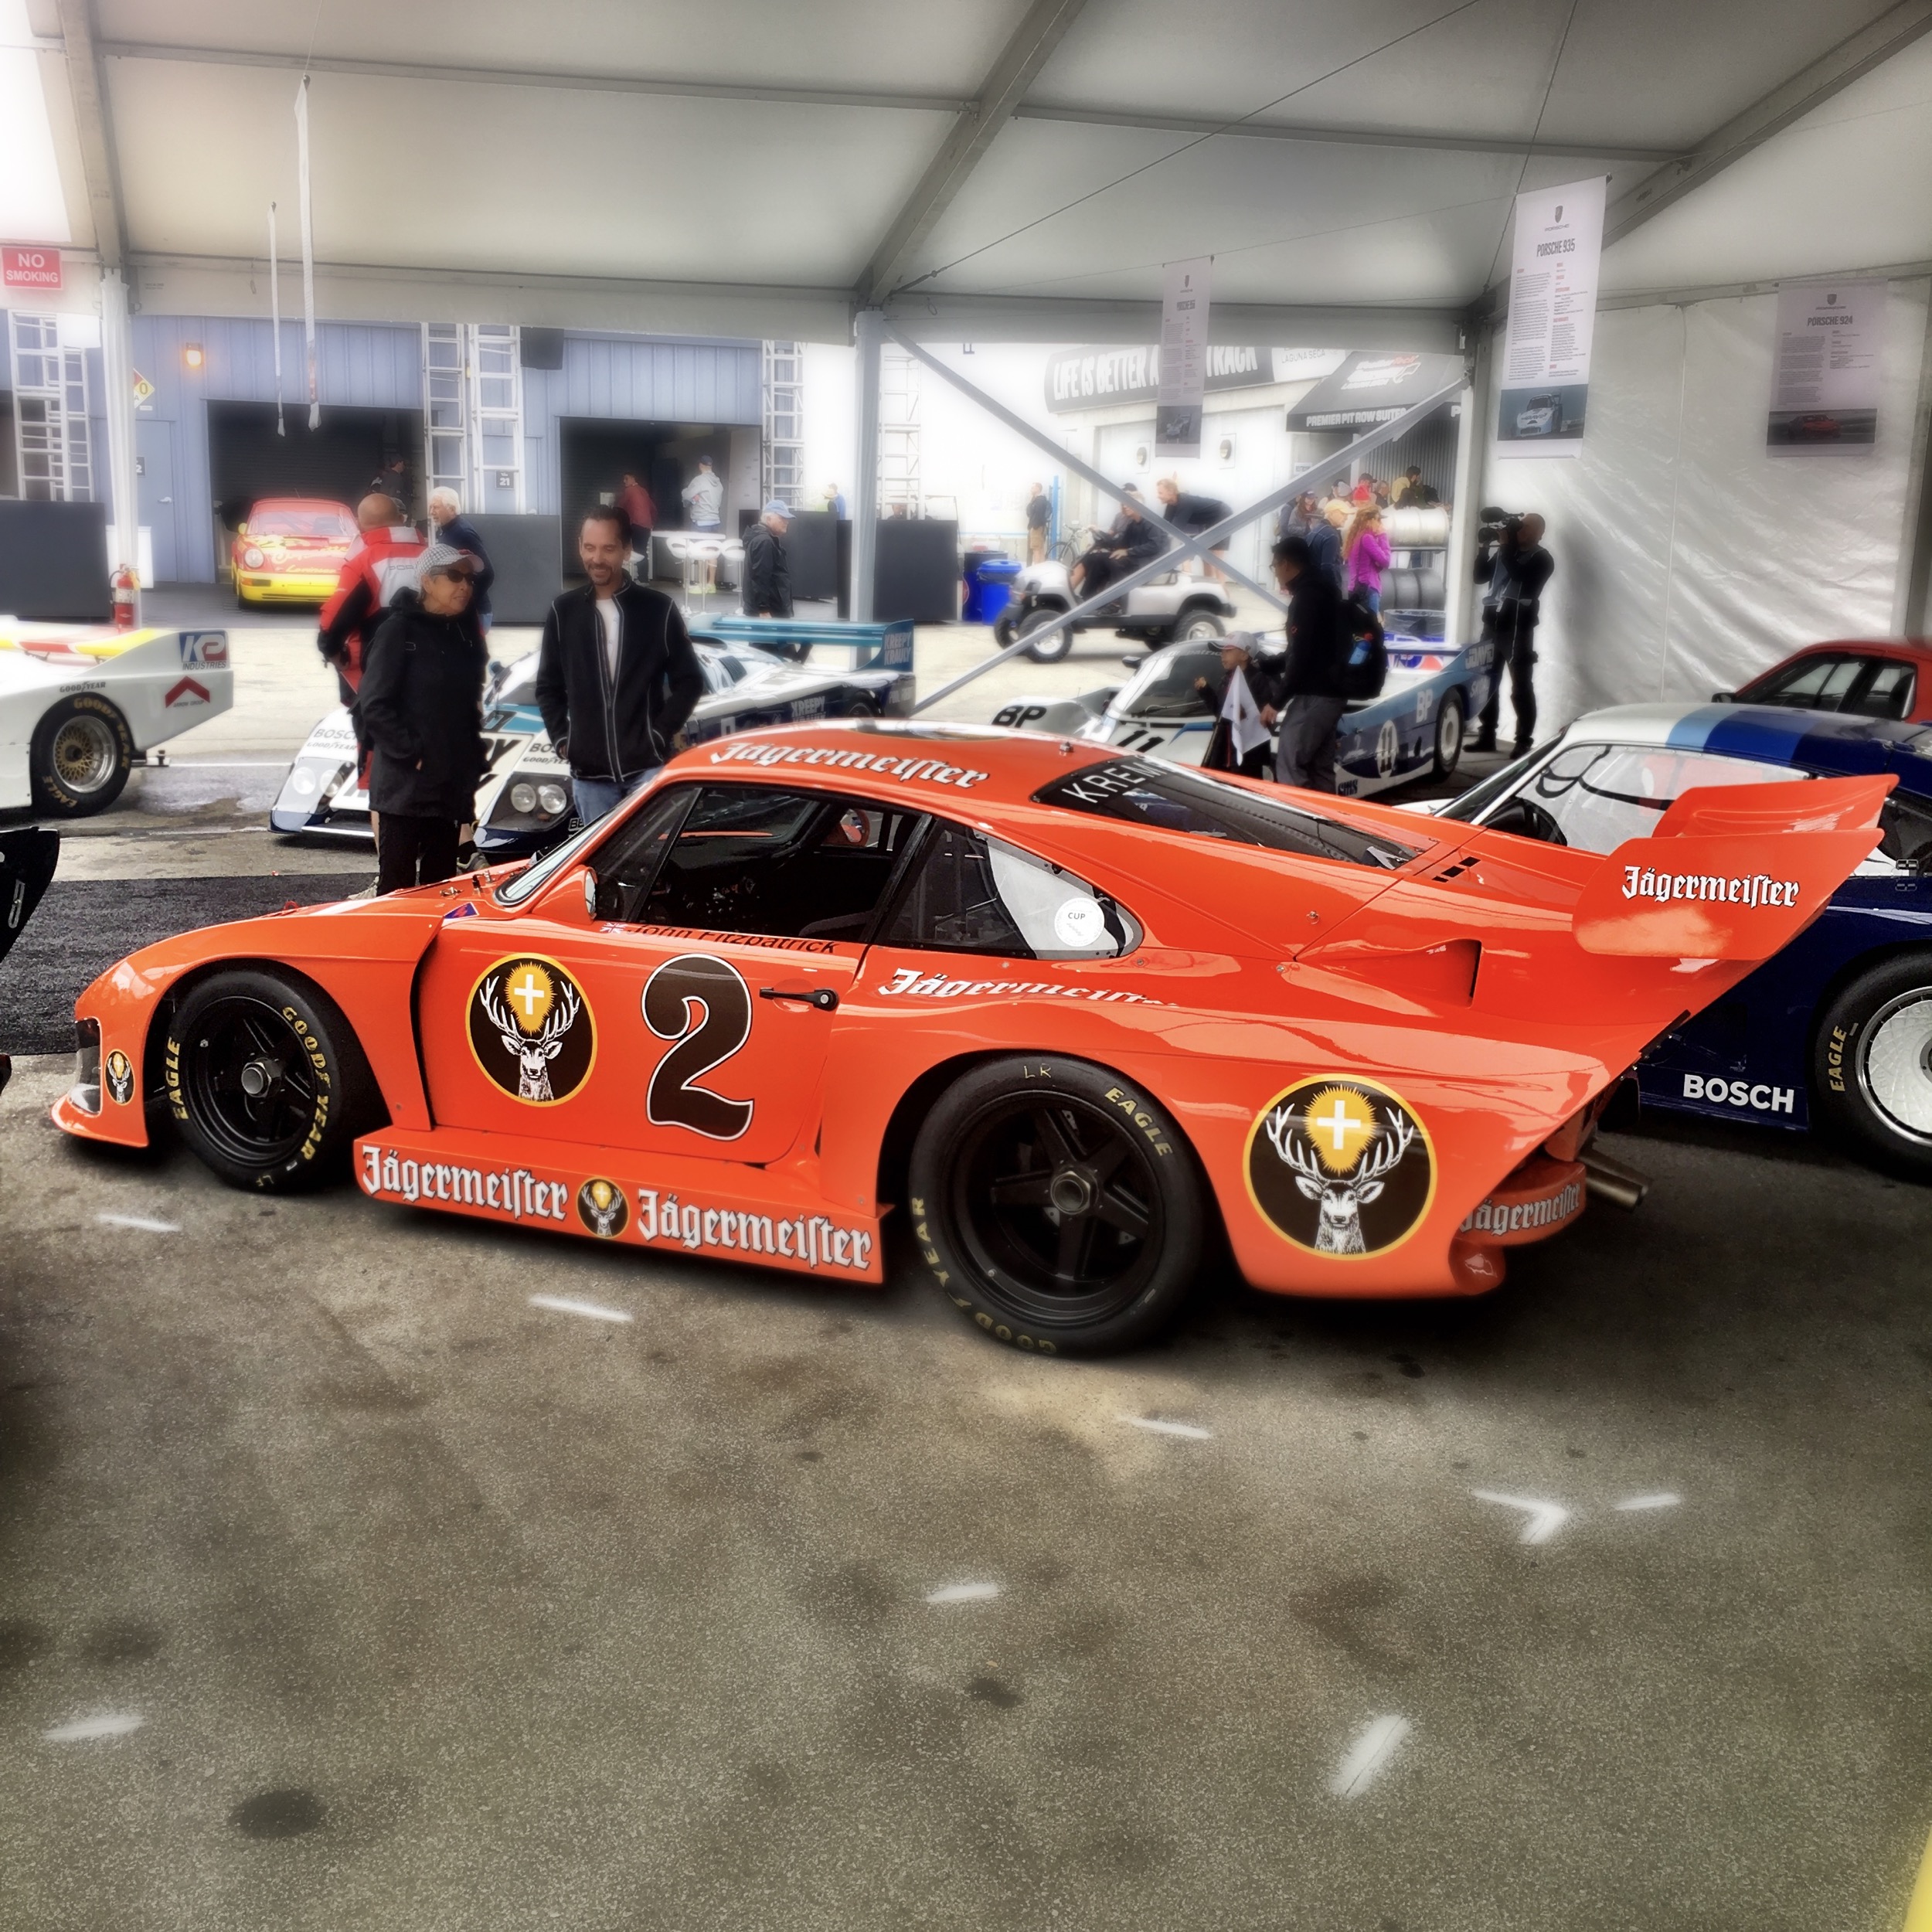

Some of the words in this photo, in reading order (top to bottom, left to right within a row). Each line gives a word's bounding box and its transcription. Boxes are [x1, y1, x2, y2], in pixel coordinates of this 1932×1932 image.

[18, 253, 45, 268] NO
[1536, 240, 1562, 257] PORSCHE
[1563, 238, 1576, 253] 935
[6, 270, 58, 284] SMOKING
[1807, 316, 1838, 327] PORSCHE
[1839, 315, 1853, 325] 924
[1281, 352, 1308, 364] LAGUNA
[1308, 348, 1326, 360] SECA
[1053, 359, 1081, 401] LIFE
[1081, 355, 1095, 397] IS
[1096, 346, 1147, 394] BETTER
[139, 382, 148, 395] 0
[1306, 413, 1342, 427] PREMIER
[1342, 412, 1354, 425] PIT
[1354, 410, 1376, 423] ROW
[499, 477, 510, 486] 21
[884, 631, 912, 650] KREEPY
[182, 661, 226, 671] INDUSTRIES
[60, 681, 106, 693] GOODYEAR
[791, 696, 825, 718] KREEPY
[992, 705, 1047, 729] BP
[1416, 689, 1434, 723] BP
[1116, 730, 1165, 753] 11
[1381, 725, 1393, 773] 11
[523, 755, 570, 766] GOODYEA
[709, 742, 989, 789] Jägermeister
[43, 774, 78, 808] EAGLE
[1621, 865, 1800, 910] Jägermeister
[624, 922, 693, 941] John
[699, 930, 841, 956] Fitzpatrick
[641, 952, 755, 1142] 2
[1828, 1026, 1848, 1093] EAGLE
[165, 1036, 189, 1120] EAGLE
[281, 1005, 332, 1160] GOODYEAR
[1024, 1063, 1053, 1080] LR
[1683, 1073, 1794, 1114] BOSCH
[1104, 1087, 1174, 1158] EAGLE
[362, 1145, 567, 1220] Jägermeister
[638, 1187, 872, 1272] Jägermeister
[910, 1197, 1057, 1355] GOODYEAR
